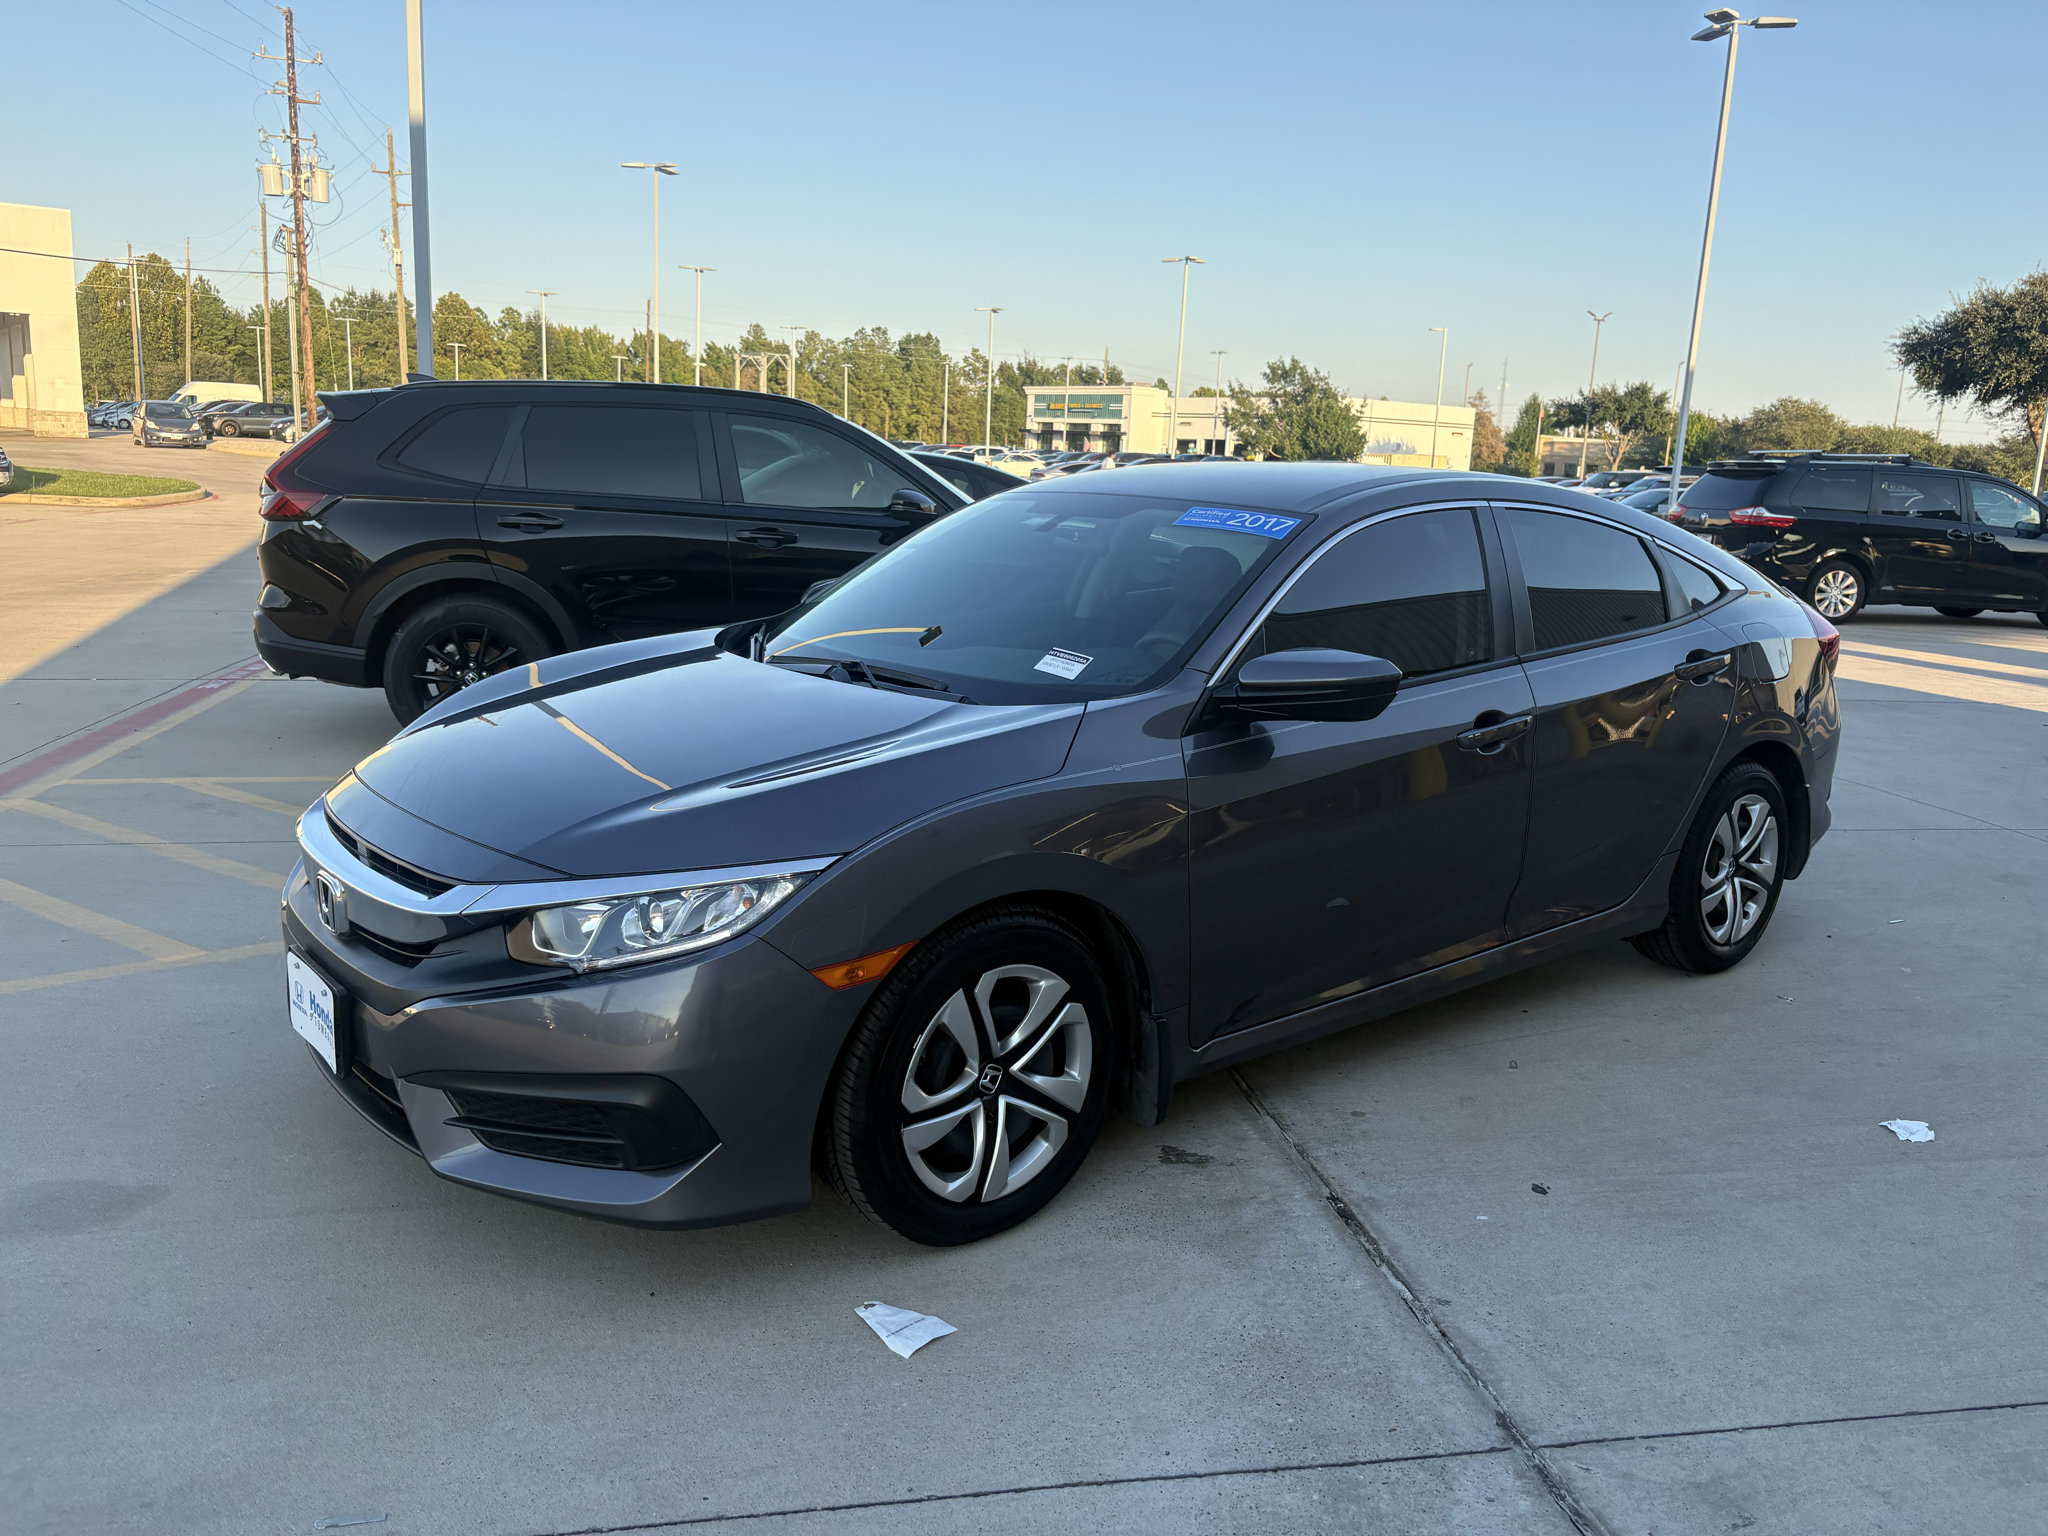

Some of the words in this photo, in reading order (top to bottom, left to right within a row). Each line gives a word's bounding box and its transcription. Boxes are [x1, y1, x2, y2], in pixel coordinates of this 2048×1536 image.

[1191, 508, 1231, 517] Certified
[1226, 512, 1295, 532] 2017
[292, 999, 308, 1017] HONDA
[309, 990, 333, 1036] Honda
